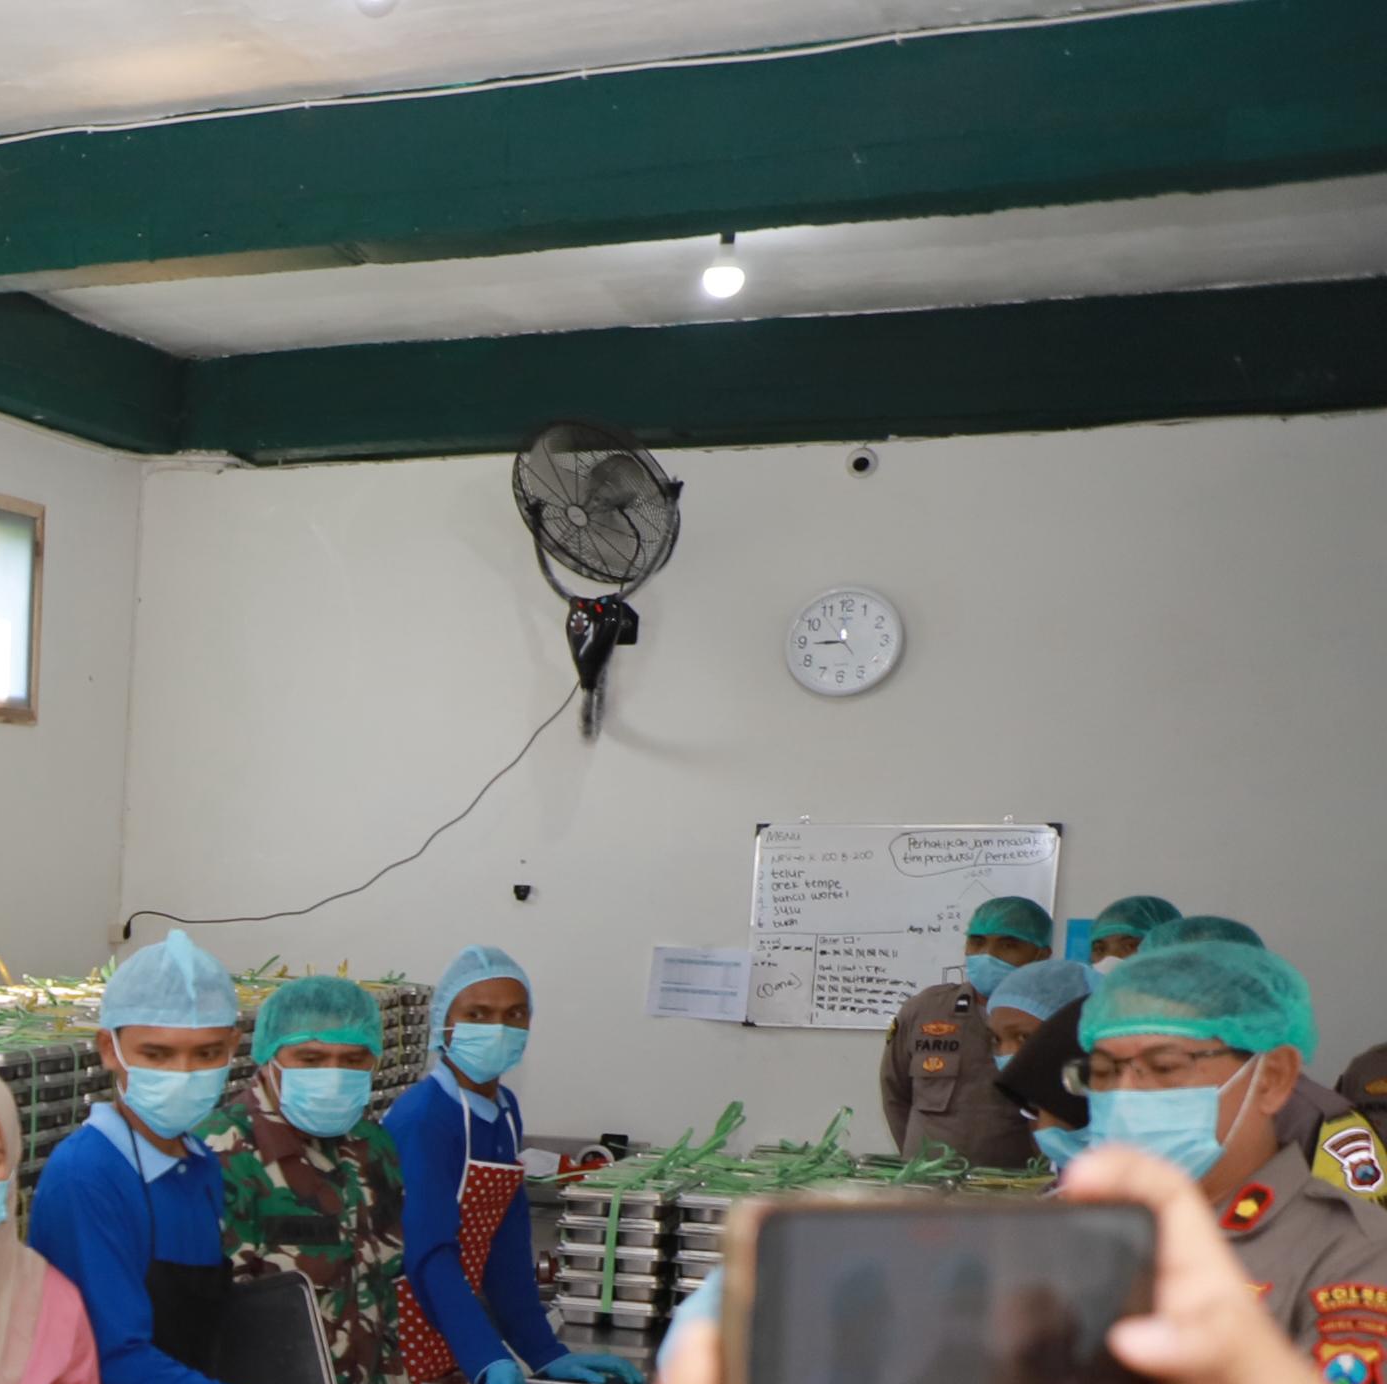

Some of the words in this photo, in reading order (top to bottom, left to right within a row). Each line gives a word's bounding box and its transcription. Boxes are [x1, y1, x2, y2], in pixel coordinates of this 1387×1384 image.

[822, 604, 834, 617] 11
[839, 598, 855, 613] 12
[862, 604, 868, 616] 1
[807, 617, 821, 631] 10
[875, 615, 885, 629] 2
[798, 636, 808, 649] 9
[880, 634, 889, 647] 3
[803, 654, 812, 667] 8
[819, 666, 827, 678] 7
[835, 670, 845, 683] 6
[856, 665, 865, 679] 5
[915, 1039, 960, 1052] FARID
